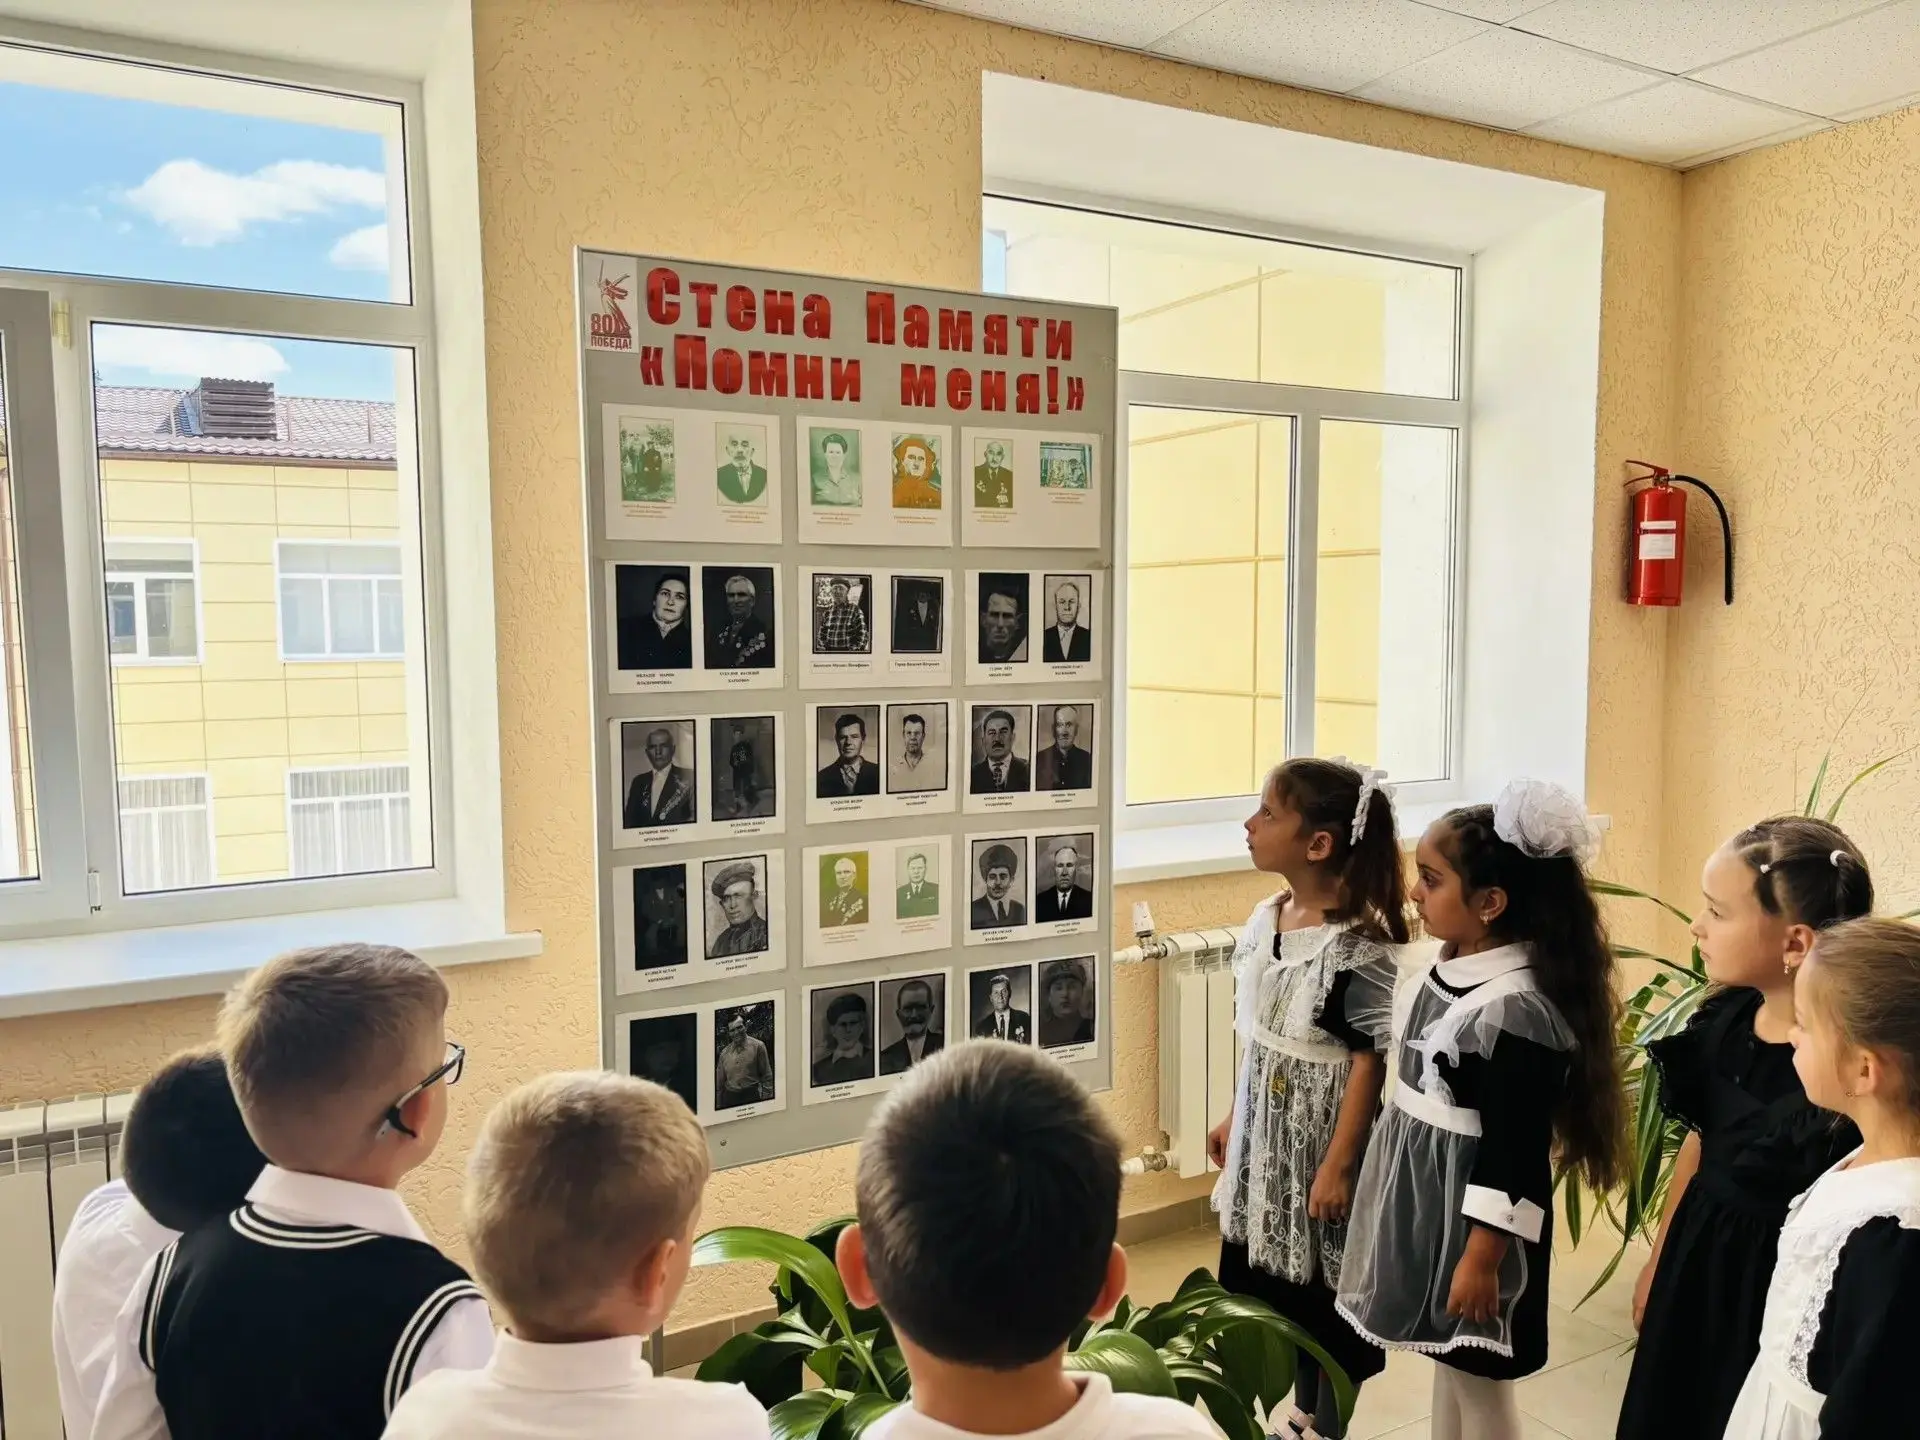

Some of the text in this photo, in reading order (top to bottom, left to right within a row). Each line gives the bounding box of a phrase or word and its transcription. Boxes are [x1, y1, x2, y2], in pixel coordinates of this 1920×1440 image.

[591, 313, 613, 334] 80
[646, 267, 1072, 361] Стена Памяти
[591, 336, 632, 350] ПОБЕДА!
[640, 333, 1085, 415] «Помни меня!»
